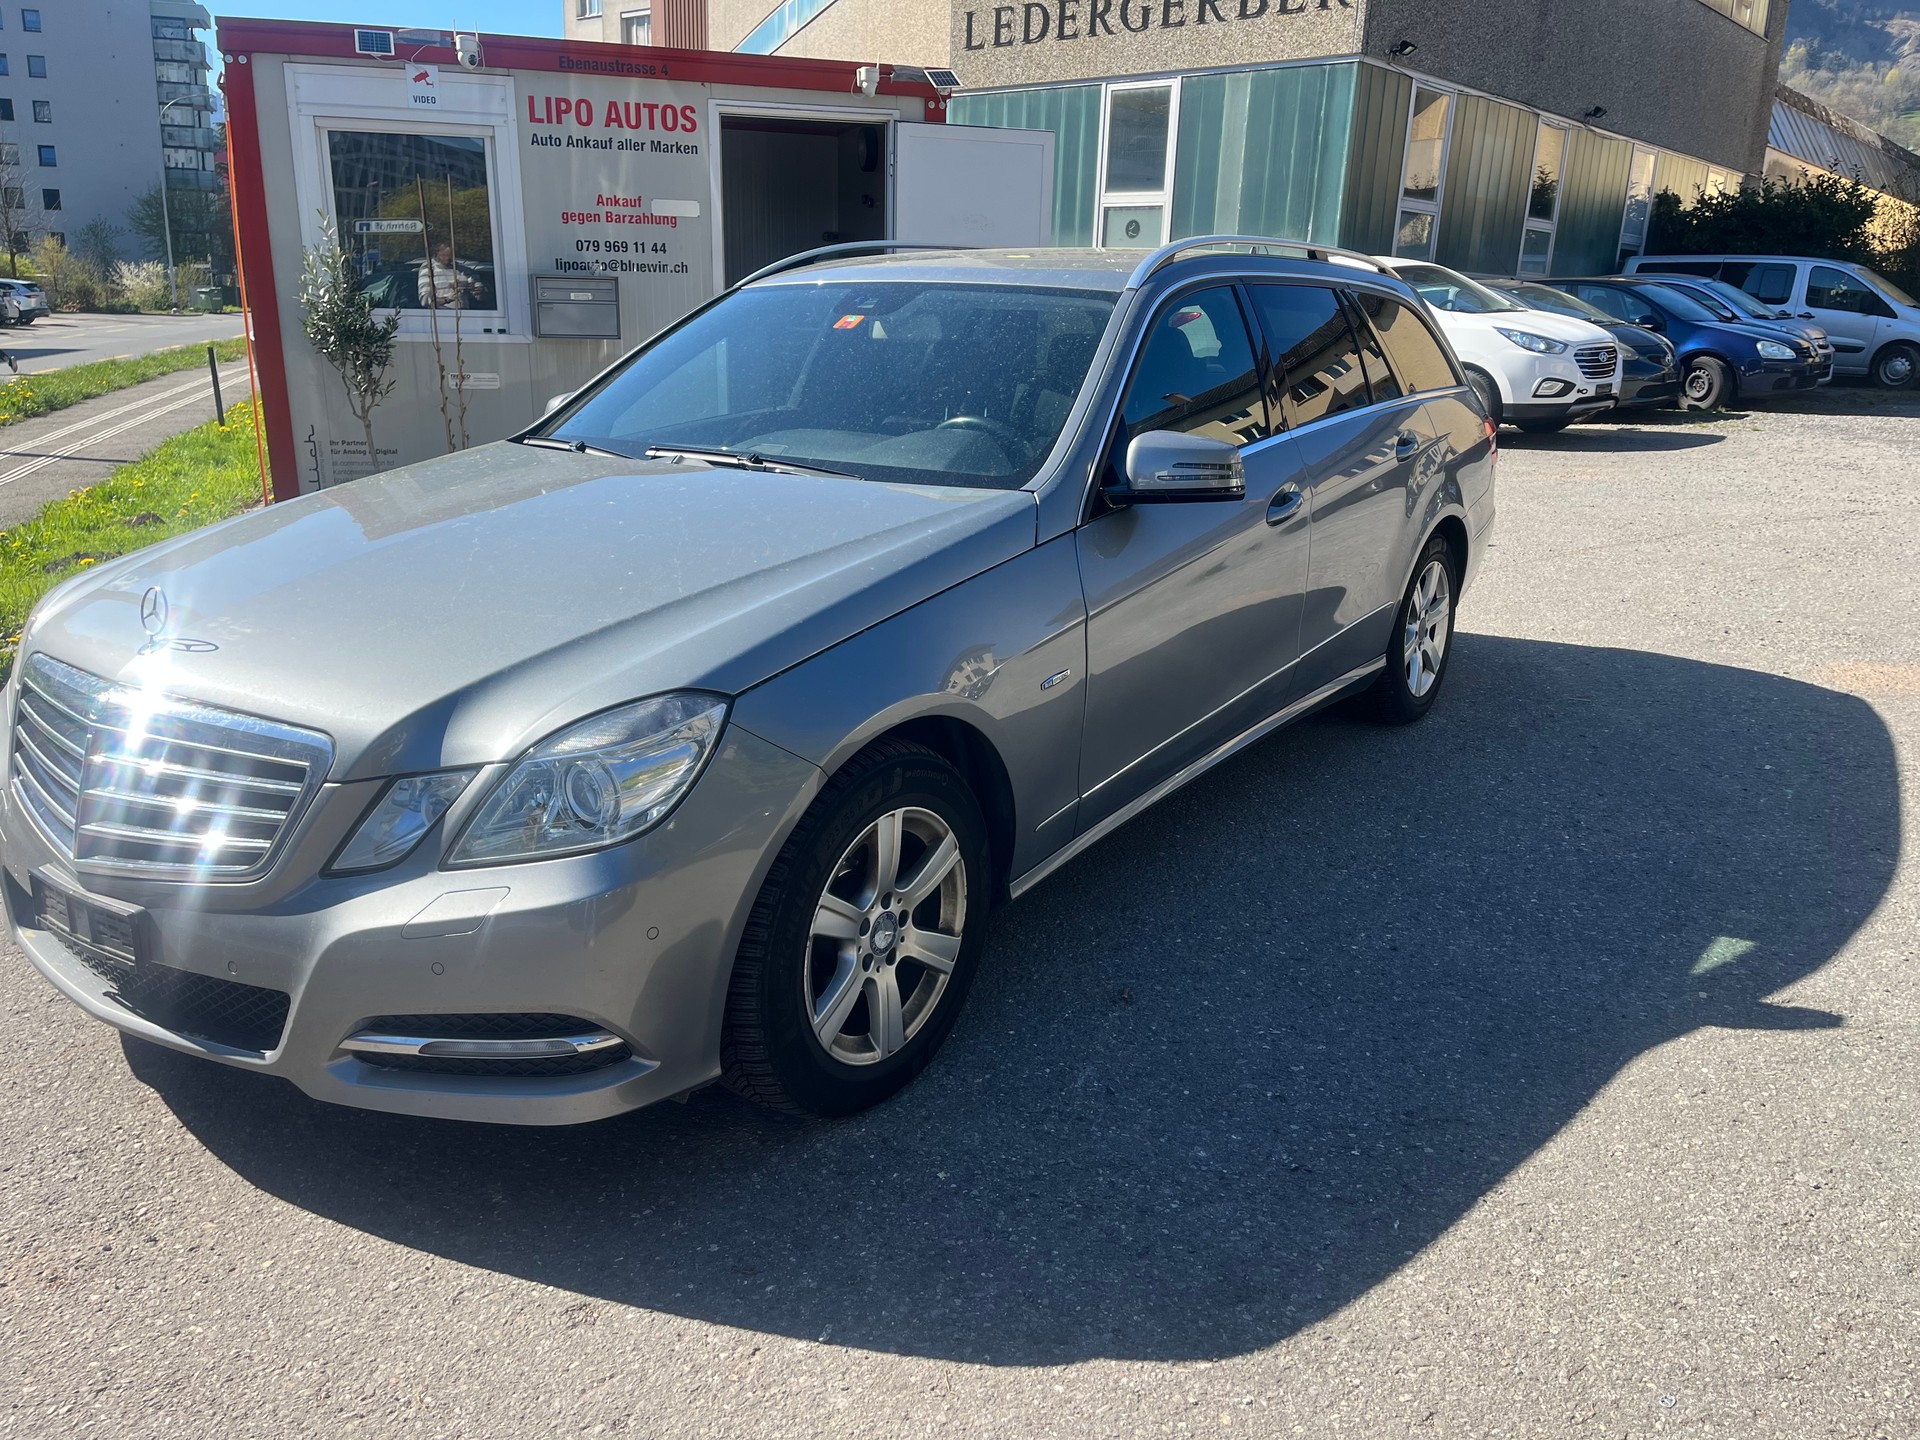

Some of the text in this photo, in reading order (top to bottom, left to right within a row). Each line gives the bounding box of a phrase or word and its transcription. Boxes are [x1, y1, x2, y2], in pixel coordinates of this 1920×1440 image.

[963, 0, 1354, 51] LEDERGER
[559, 55, 669, 76] Ebenaustrasse 4
[413, 95, 436, 105] VIDEO
[527, 95, 697, 133] LIPO AUTOS
[531, 133, 698, 155] Auto Ankauf aller Marken
[596, 194, 643, 208] Ankauf
[561, 211, 678, 229] gegen Barzahlung
[576, 239, 667, 254] 079 969 11 44
[303, 424, 321, 491] lich
[342, 448, 367, 456] Analog
[375, 448, 398, 456] Digital
